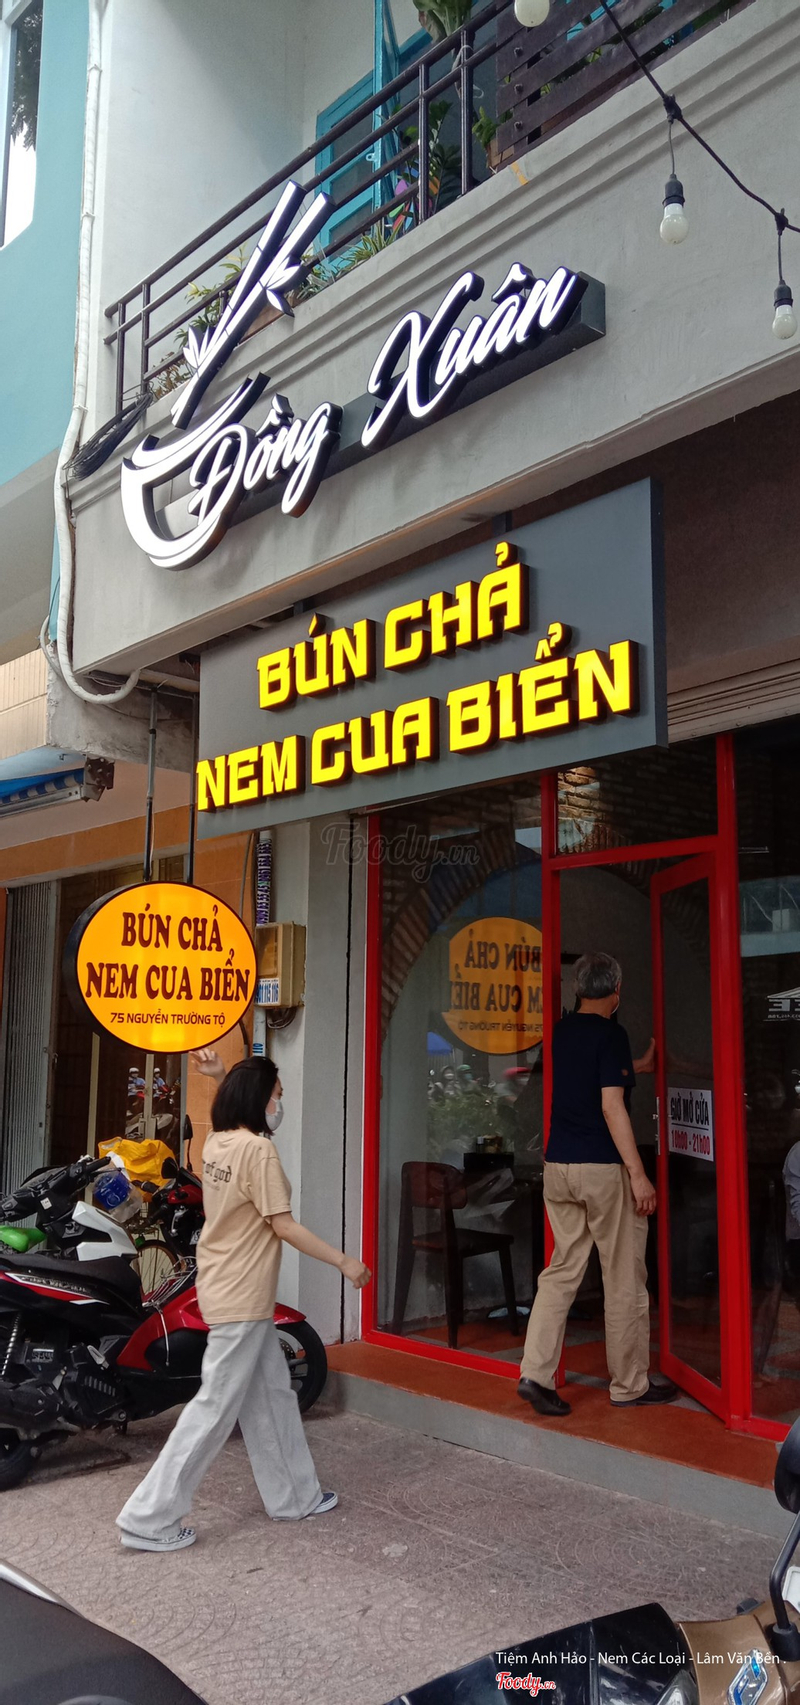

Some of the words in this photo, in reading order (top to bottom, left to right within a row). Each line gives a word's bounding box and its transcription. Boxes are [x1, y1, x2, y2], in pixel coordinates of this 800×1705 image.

[187, 393, 334, 517] Đồng
[361, 261, 579, 449] Xuân
[257, 615, 368, 710] BÚN
[384, 541, 522, 671] CHẢ
[196, 735, 299, 812] NEM
[311, 697, 432, 785] CUA
[446, 622, 631, 753] BIỂN
[120, 903, 172, 949] BÚN
[177, 904, 223, 952] CHẢ
[85, 962, 140, 999] NEM
[145, 965, 193, 1001] CUA
[199, 948, 251, 1002] BIỂN
[110, 1012, 125, 1023] 75
[126, 1008, 169, 1024] NGUYỄN
[170, 1011, 211, 1025] TRƯỜNG
[212, 1012, 226, 1028] TỘ
[694, 1091, 710, 1126] CỬA
